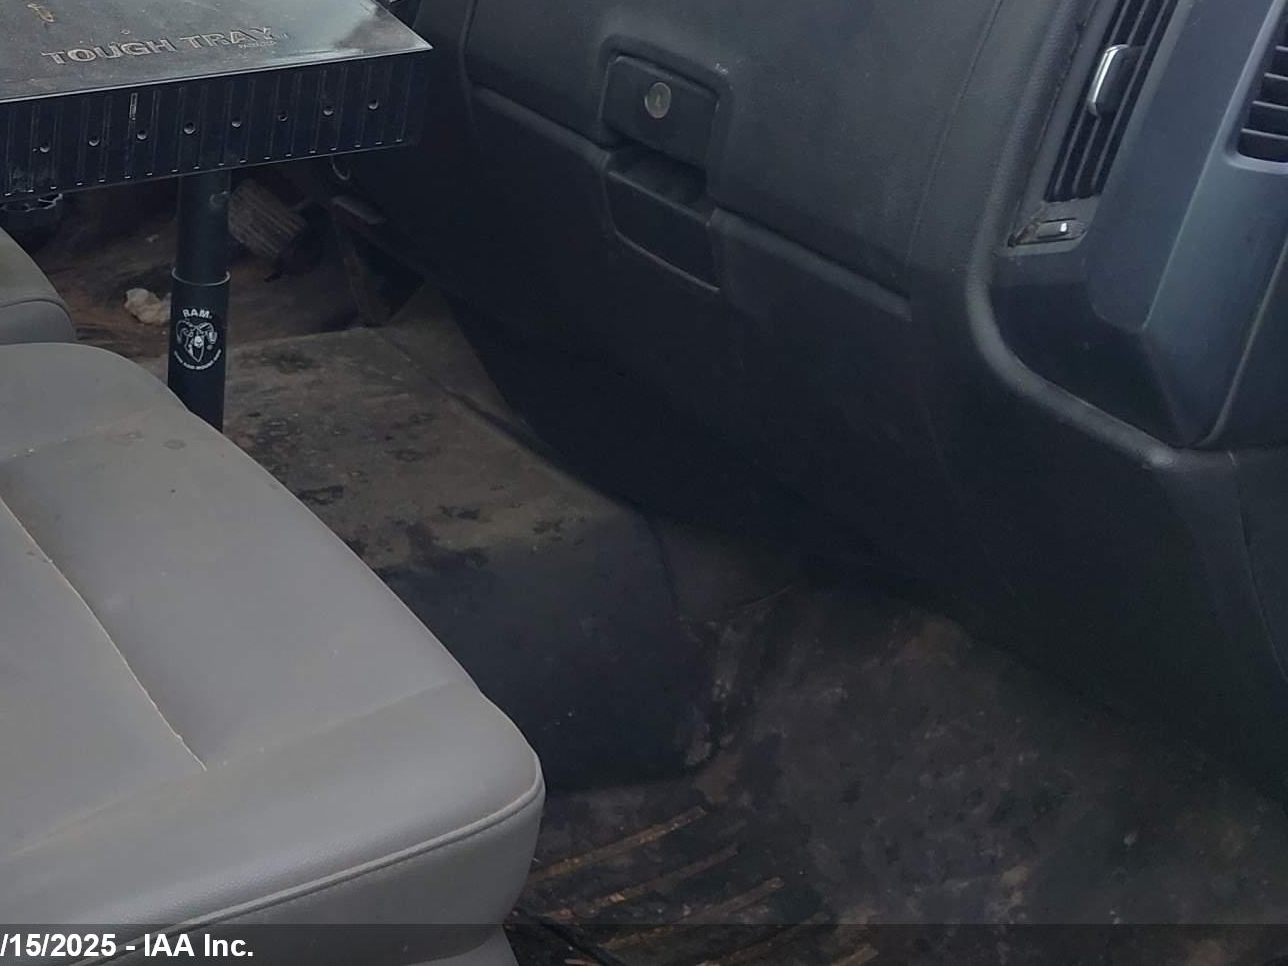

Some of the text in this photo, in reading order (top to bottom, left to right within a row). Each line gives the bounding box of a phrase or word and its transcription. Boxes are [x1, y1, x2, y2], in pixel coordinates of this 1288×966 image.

[42, 38, 178, 66] TOUGH
[179, 27, 273, 50] TRAY
[182, 308, 210, 319] RAM
